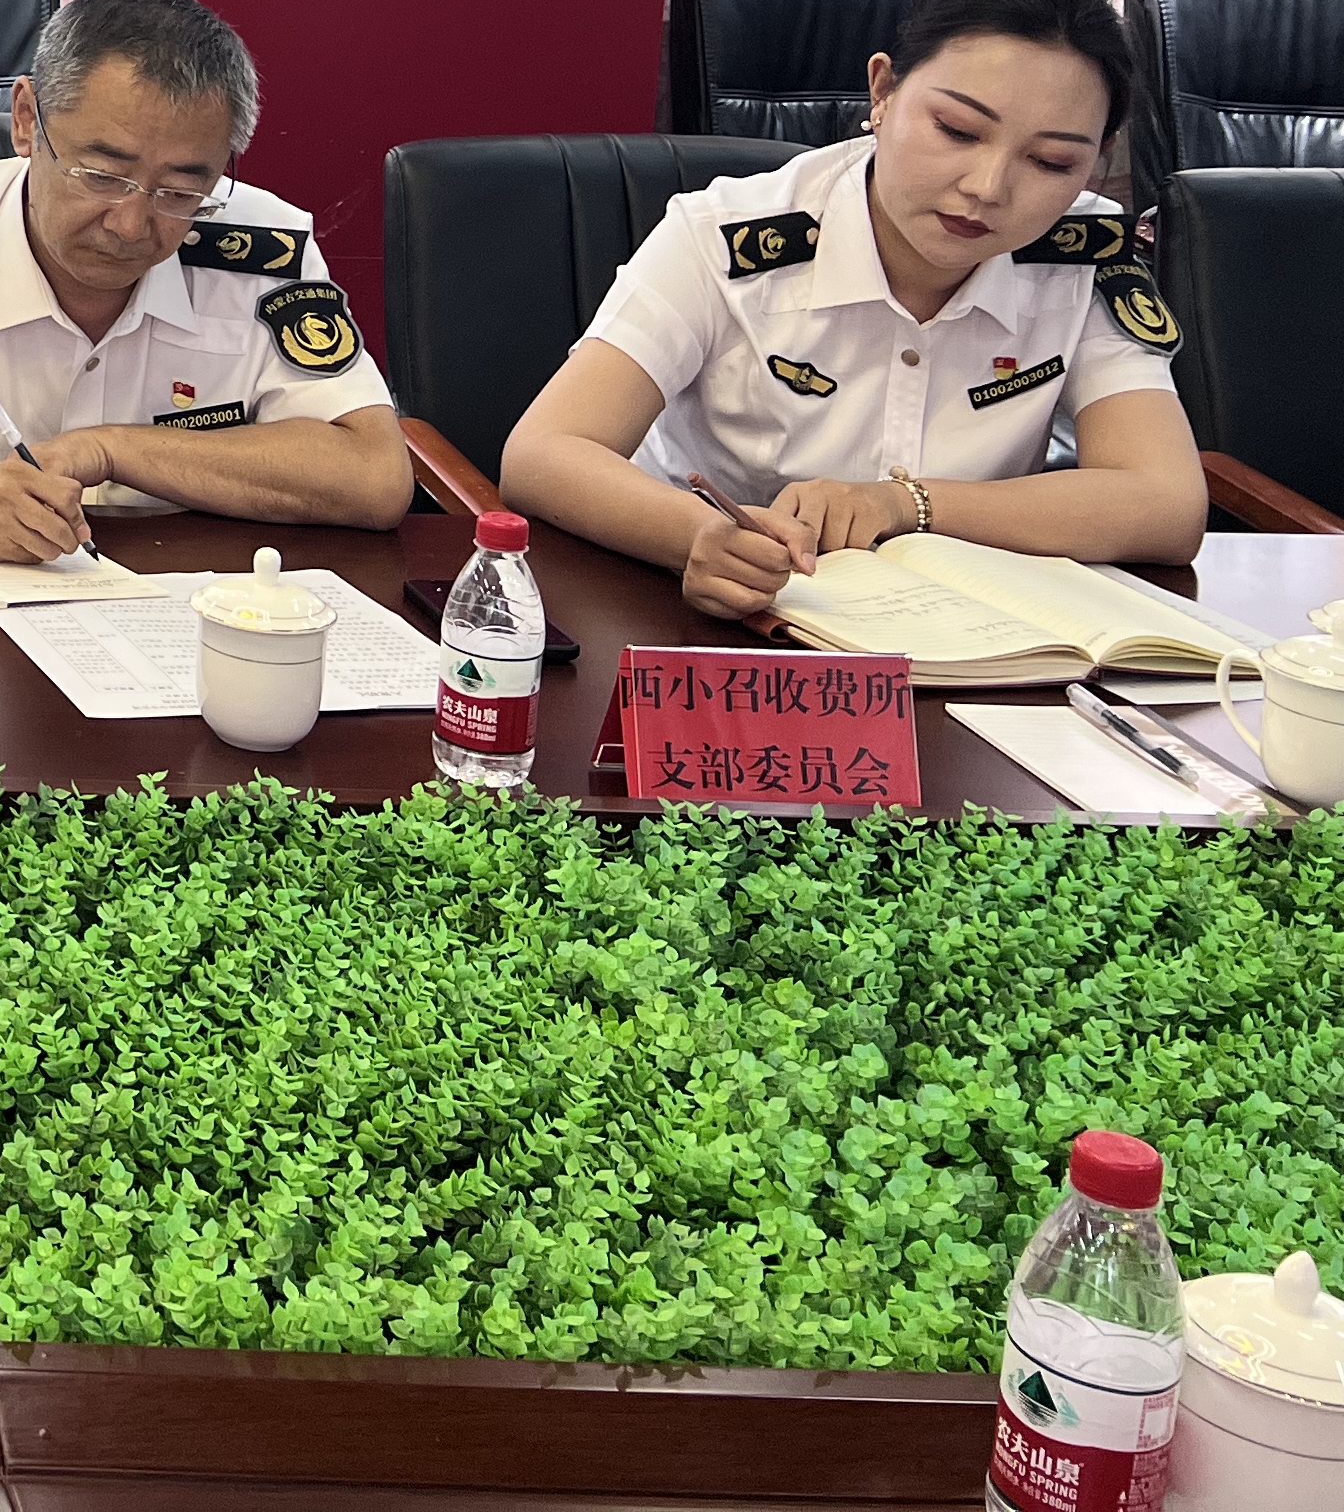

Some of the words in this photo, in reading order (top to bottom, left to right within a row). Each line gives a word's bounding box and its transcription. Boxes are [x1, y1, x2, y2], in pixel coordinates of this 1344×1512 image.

[972, 360, 1060, 403] 01002003012
[442, 694, 499, 724] 农夫山泉
[620, 664, 911, 720] 西小召收费所
[647, 742, 890, 797] 支部委员会
[997, 1416, 1080, 1486] 农夫山泉
[1029, 1470, 1078, 1501] SPRING
